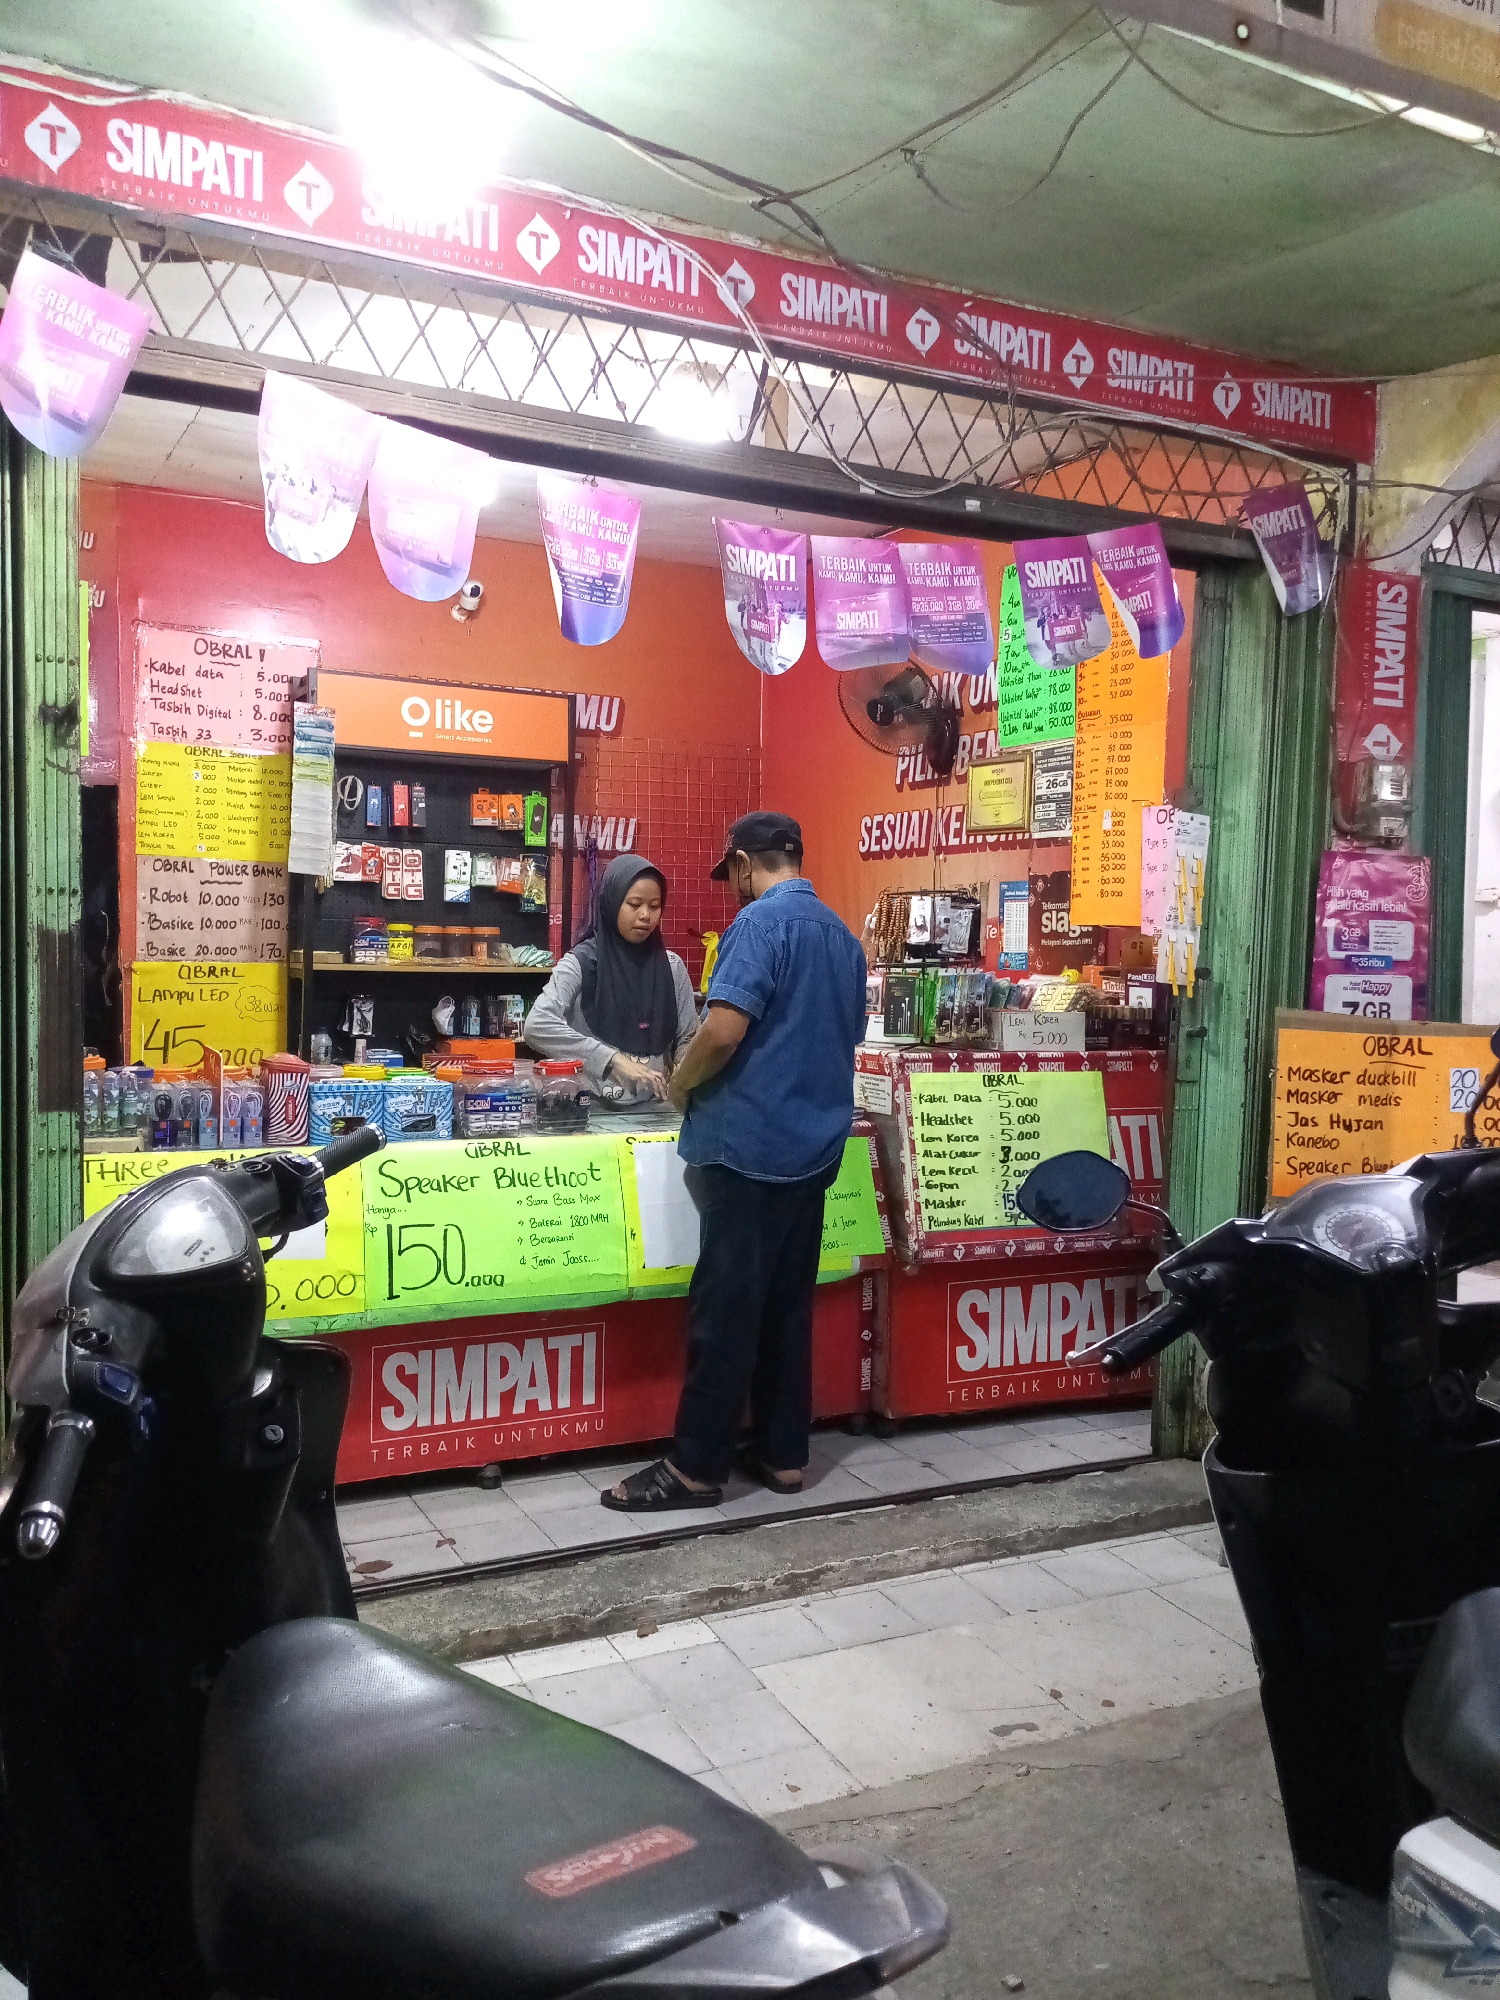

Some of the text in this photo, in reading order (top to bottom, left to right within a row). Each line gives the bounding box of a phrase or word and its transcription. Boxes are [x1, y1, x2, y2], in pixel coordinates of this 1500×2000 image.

[106, 118, 263, 202] SIMPATI
[187, 195, 271, 222] UNTUKMU
[355, 231, 504, 270] TERBAIK UNTUKMU
[577, 225, 699, 297] SIMPATI
[572, 278, 631, 300] TERBAIK
[780, 272, 888, 336] SIMPATI
[954, 312, 1051, 372] SIMPATI
[1107, 347, 1194, 402] SIMPATI
[1252, 382, 1331, 430] SIMPATI
[563, 518, 594, 539] KAMU,
[600, 517, 629, 533] UNTUK
[1254, 505, 1304, 538] SIMPATI
[725, 544, 796, 582] SIMPATI
[1098, 544, 1136, 563] TERBAIK
[820, 555, 892, 574] TERBAIK UNTUK
[908, 561, 975, 576] TERBAIK UNTUK
[1025, 557, 1086, 588] SIMPATI
[838, 571, 865, 584] KAMU,
[868, 572, 896, 585] KAMU!
[926, 577, 952, 587] KAMU,
[751, 619, 770, 636] SIMPATI
[836, 610, 879, 630] SIMPATI
[1054, 625, 1076, 638] SIMPATI
[193, 638, 253, 660] OBRAL
[1373, 581, 1407, 708] SIMPATI
[149, 658, 185, 677] Kabel
[196, 666, 224, 679] data
[197, 705, 232, 720] Digital
[195, 729, 212, 740] 33
[435, 733, 455, 742] Smart
[858, 809, 930, 852] SESUAI
[153, 857, 283, 878] OBRAL POWER BANK
[149, 887, 189, 905] Robot
[1346, 887, 1369, 900] yang
[1041, 901, 1070, 911] Telkomsel
[1353, 900, 1379, 912] kasih
[178, 964, 245, 980] OBRAL
[199, 988, 230, 1002] LED
[1361, 980, 1391, 995] Happy
[1363, 1036, 1433, 1057] OBRAL
[973, 1062, 1001, 1073] SIMPATI
[1038, 1061, 1065, 1073] SIMPATI
[1107, 1061, 1133, 1072] SIMPATI
[1287, 1066, 1351, 1085] Masker
[1356, 1068, 1417, 1087] duckbill
[997, 1094, 1038, 1108] 5.000
[1286, 1088, 1402, 1107] Masker medis
[1000, 1112, 1041, 1126] 5.000
[1287, 1111, 1319, 1128] Jas
[946, 1133, 980, 1143] Korea
[1000, 1128, 1040, 1141] 5.000
[1286, 1132, 1340, 1151] Kanebo
[868, 1136, 880, 1169] SIMPATI
[1286, 1156, 1351, 1178] Speaker
[378, 1159, 480, 1203] Speaker
[924, 1196, 967, 1210] Masker
[880, 1214, 893, 1248] SIMPATI
[862, 1277, 873, 1311] SIMPATI
[380, 1331, 598, 1432] SIMPATI
[861, 1358, 872, 1391] SIMPATI
[947, 1379, 1041, 1404] TERBAIK
[371, 1418, 605, 1463] TERBAIK UNTUKMU
